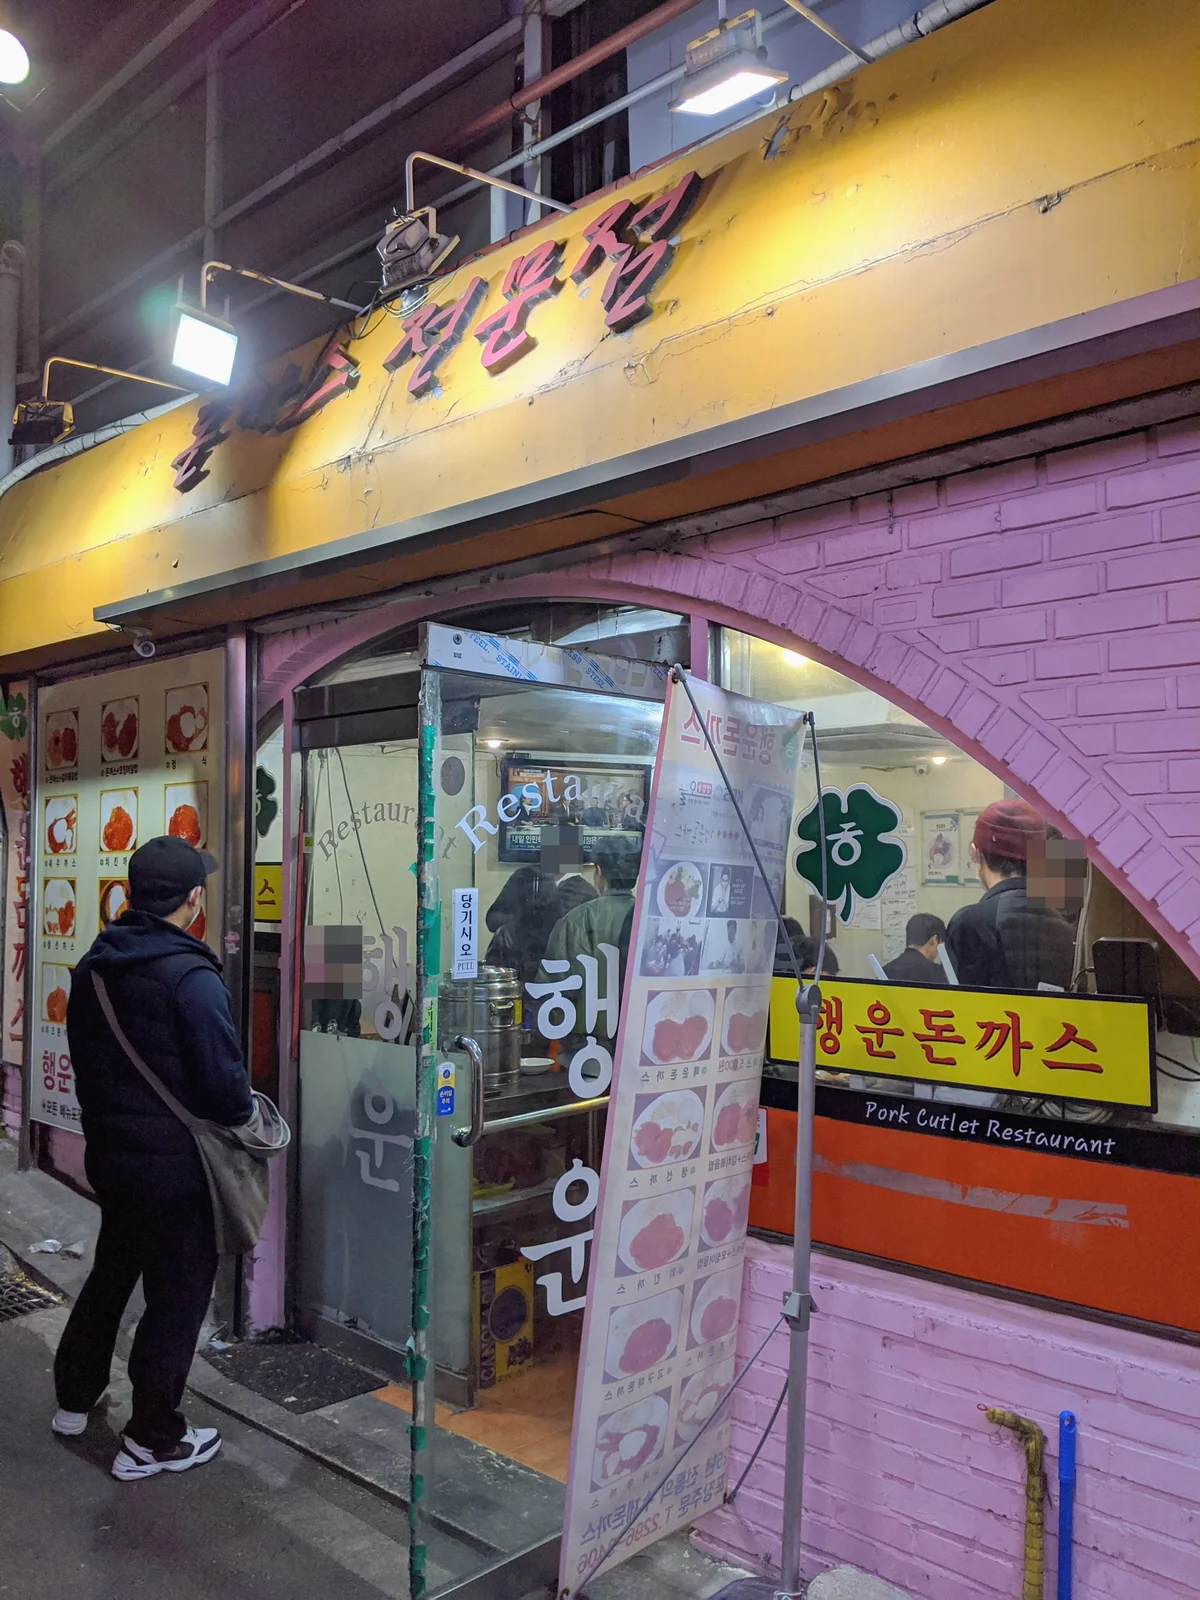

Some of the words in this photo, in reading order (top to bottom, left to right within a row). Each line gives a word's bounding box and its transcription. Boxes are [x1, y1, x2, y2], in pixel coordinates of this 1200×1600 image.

[383, 171, 702, 398] 전문점
[585, 667, 605, 689] STEEL
[459, 893, 474, 957] 당기시오
[456, 960, 475, 972] PULL
[816, 996, 1104, 1076] 행운돈까스
[43, 1050, 72, 1093] 행운
[518, 943, 620, 1317] 행운
[865, 1101, 909, 1125] Pork
[916, 1109, 980, 1136] Cutlet
[987, 1120, 1116, 1155] Restaurant
